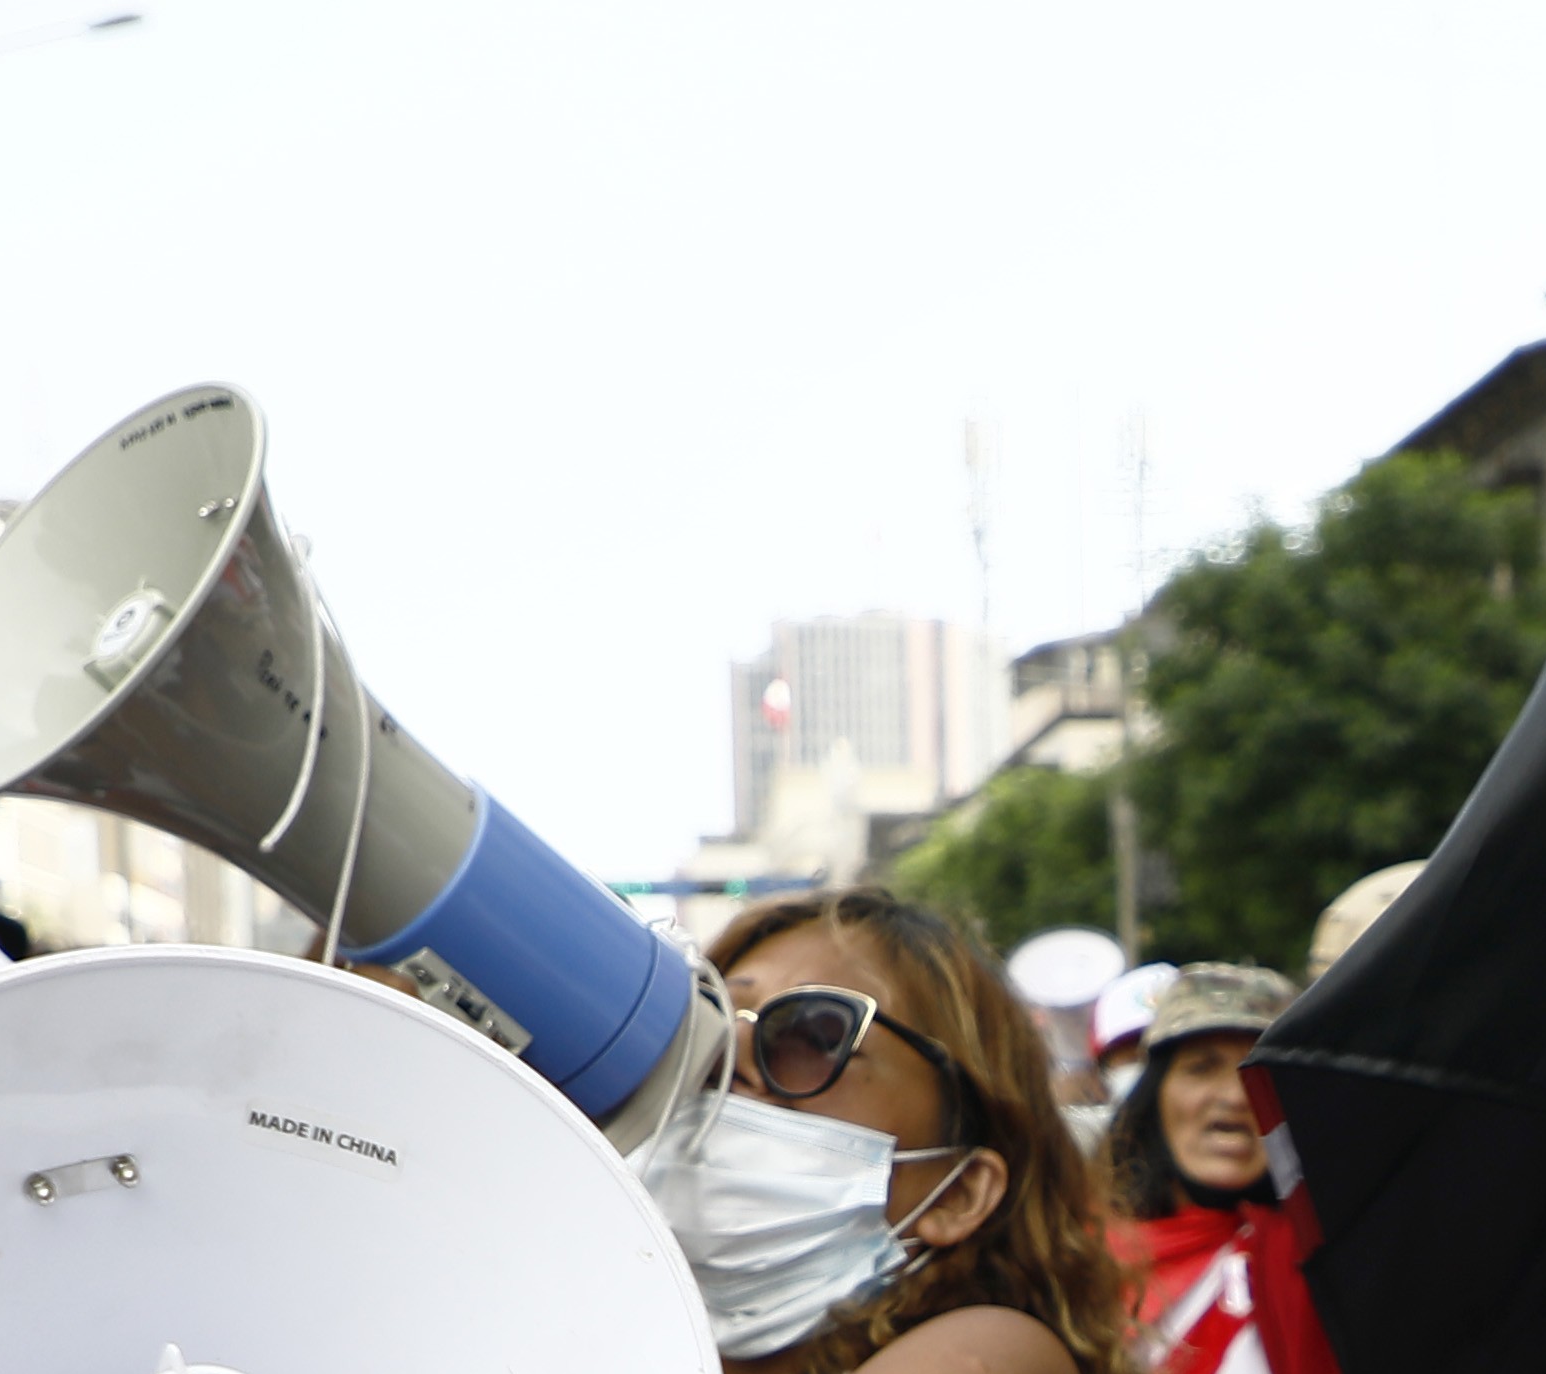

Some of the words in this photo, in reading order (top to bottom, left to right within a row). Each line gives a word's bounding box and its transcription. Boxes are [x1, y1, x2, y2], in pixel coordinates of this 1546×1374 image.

[249, 1111, 309, 1138] MADE
[312, 1126, 333, 1144] IN
[336, 1134, 398, 1166] CHINA
